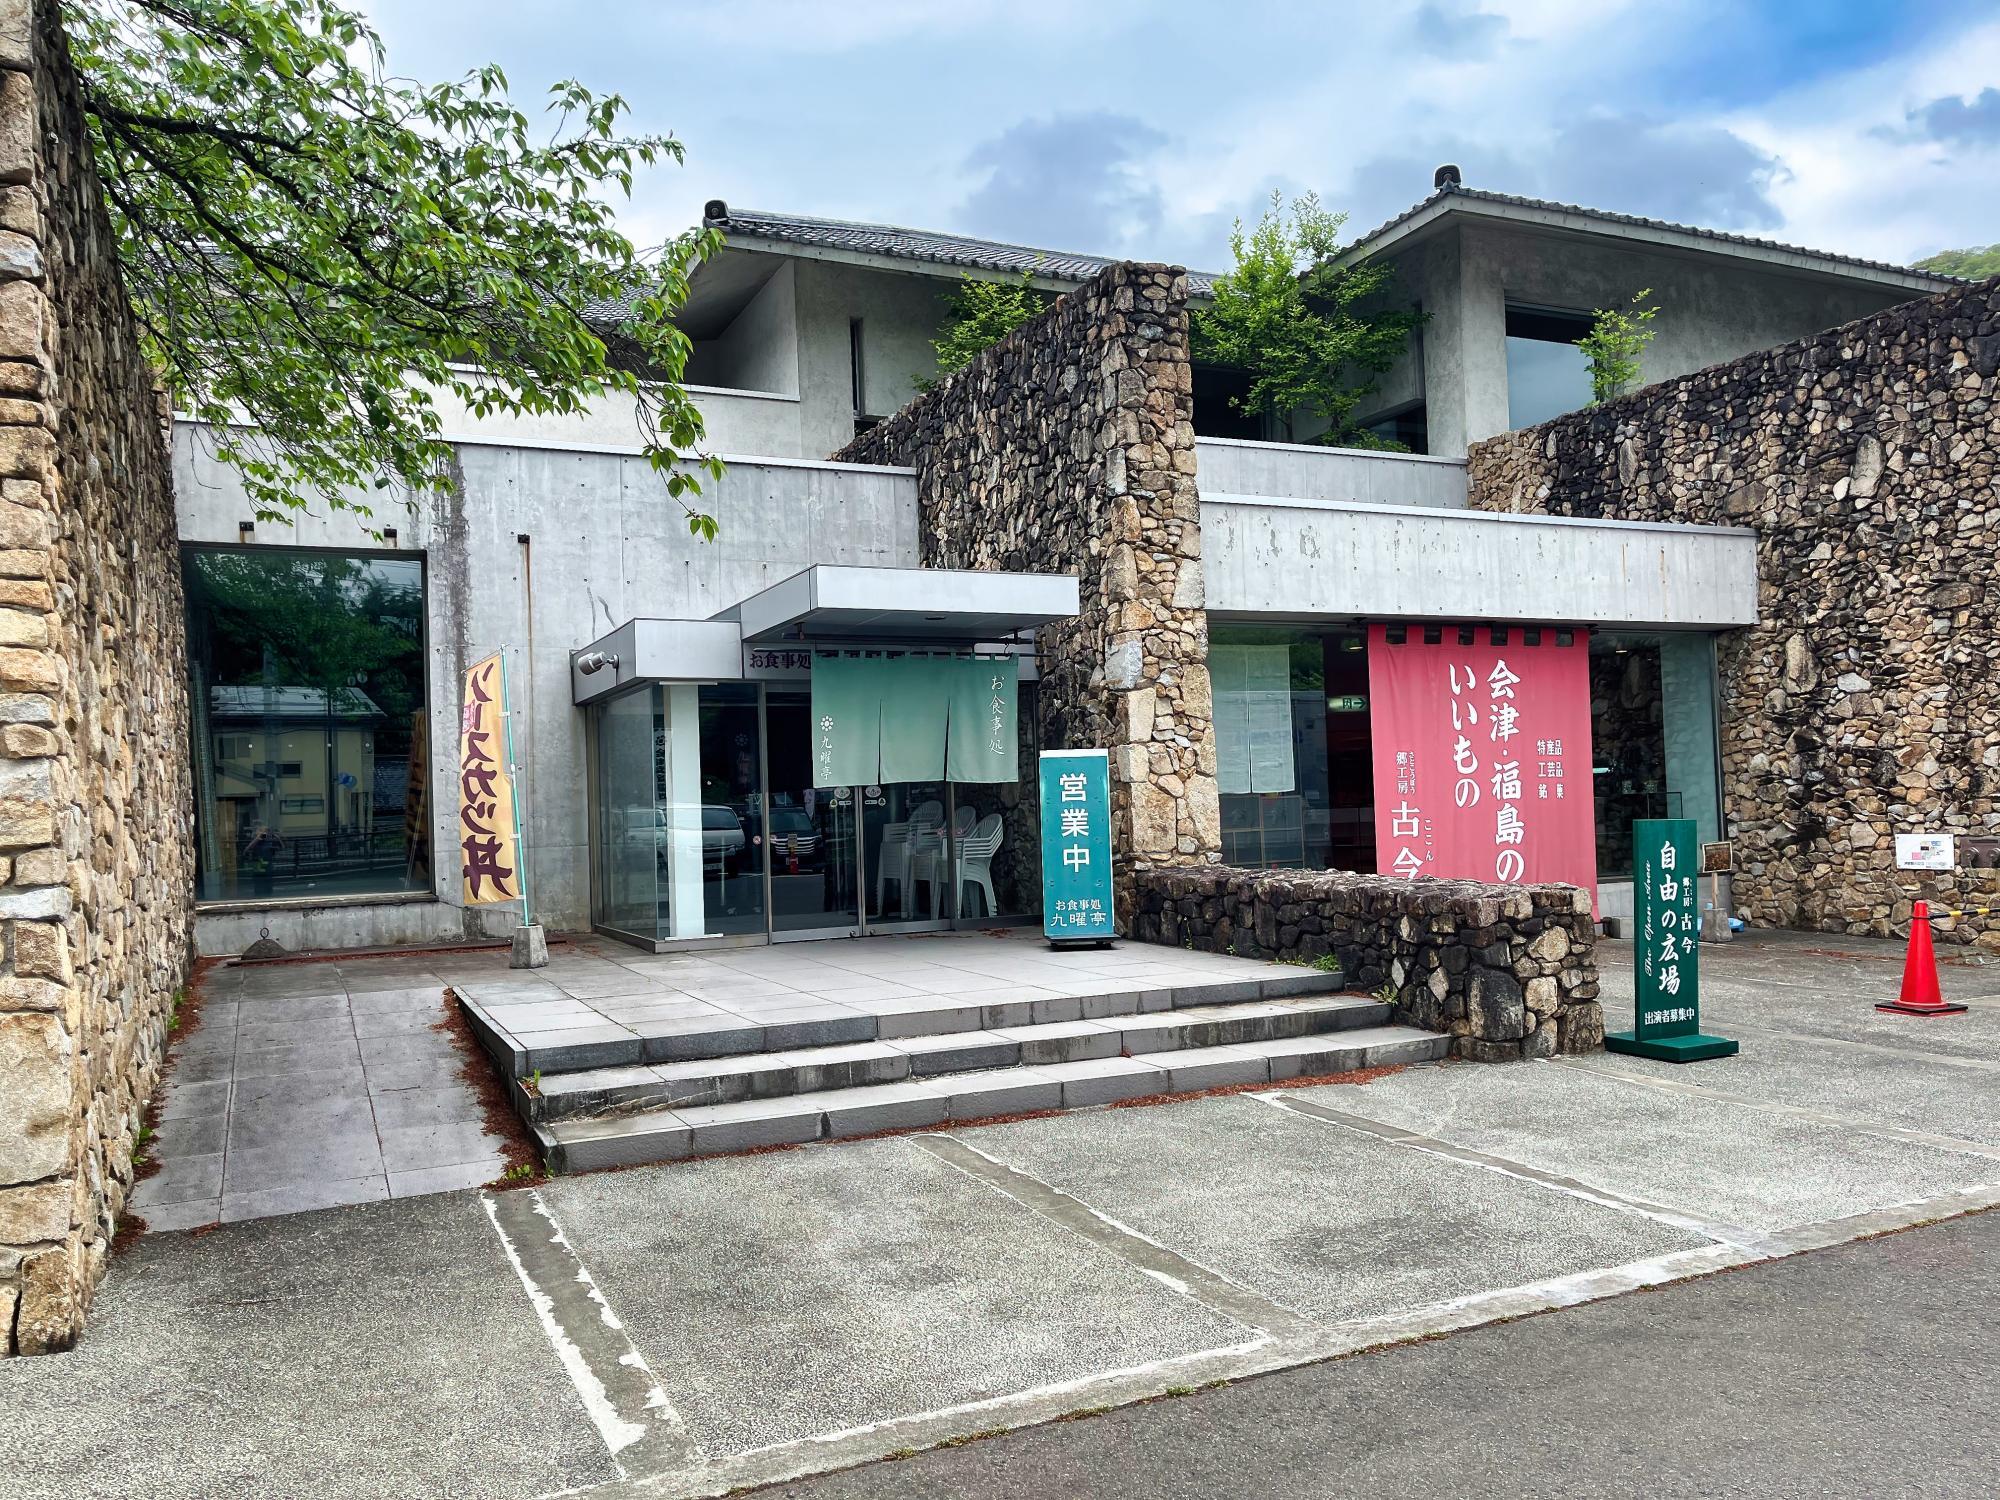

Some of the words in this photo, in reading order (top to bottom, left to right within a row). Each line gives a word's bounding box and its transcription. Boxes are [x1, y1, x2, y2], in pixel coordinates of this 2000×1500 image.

[749, 651, 812, 669] お食事処
[987, 675, 1006, 756] お食事処
[1449, 663, 1481, 808] いいもの
[1536, 739, 1563, 756] 特産品
[819, 735, 833, 781] 九曜亭
[1487, 659, 1526, 882] 会津・福島の
[1538, 761, 1564, 778] 工芸品
[1059, 773, 1090, 873] 営業中
[1424, 818, 1434, 862] ここん
[1051, 911, 1107, 927] 九曜亭
[1055, 899, 1102, 911] お食事処
[1644, 903, 1655, 941] Open
[1658, 840, 1681, 995] 自由の広場
[1644, 947, 1653, 977] The
[1644, 1007, 1695, 1026] 出演者募集中
